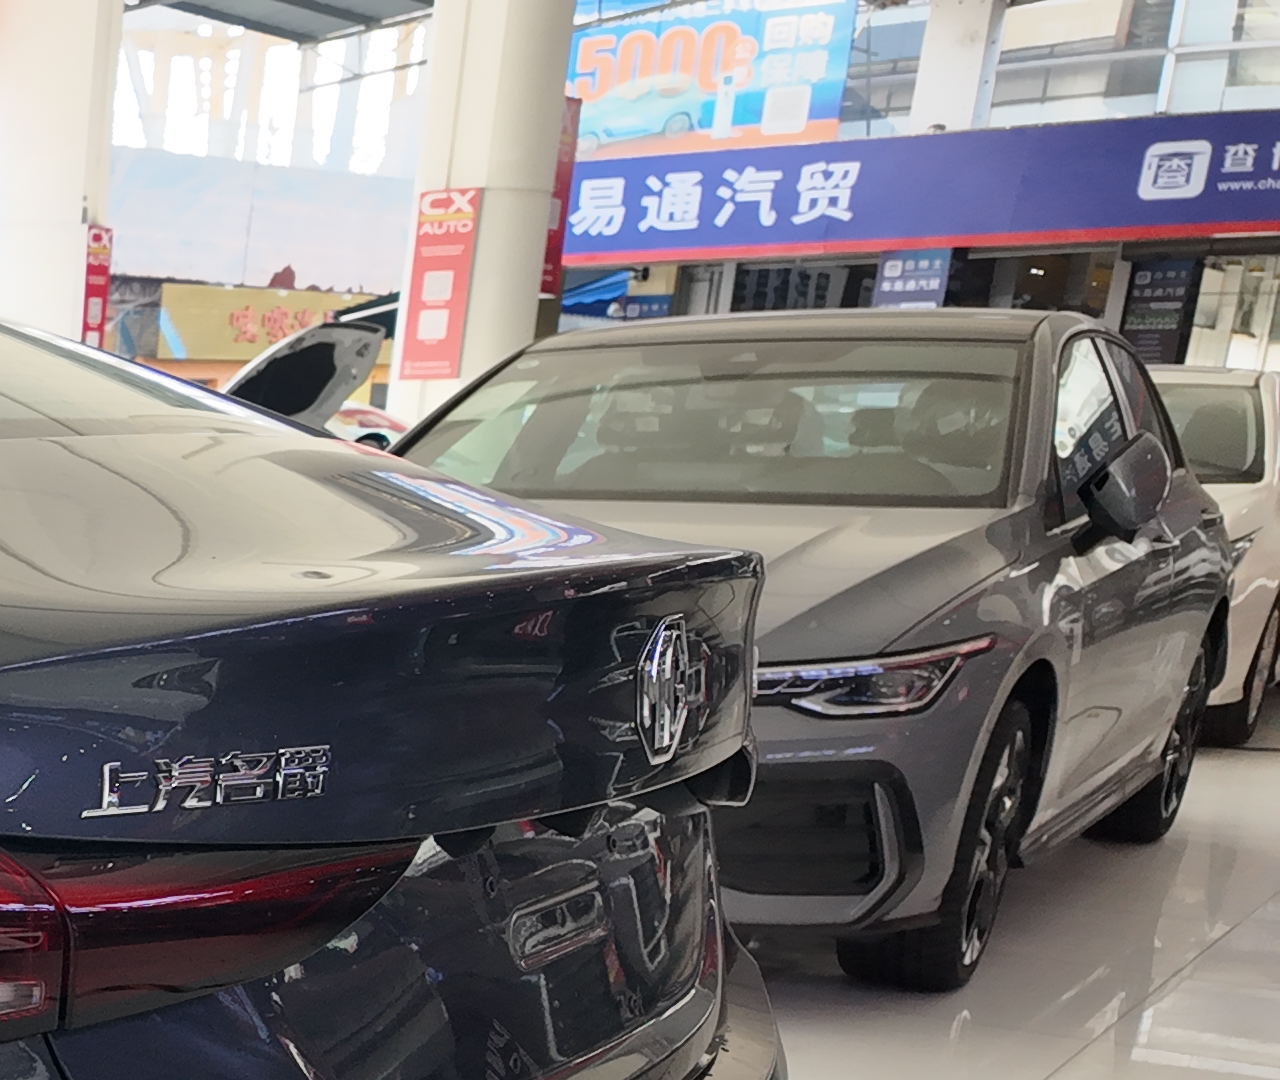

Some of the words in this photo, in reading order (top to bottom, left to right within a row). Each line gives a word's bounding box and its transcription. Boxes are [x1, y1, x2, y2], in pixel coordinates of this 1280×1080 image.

[575, 21, 742, 103] 5000
[1220, 142, 1280, 173] 查
[421, 190, 477, 215] CX
[568, 160, 862, 237] 易通汽贸
[88, 228, 113, 250] CX
[419, 219, 475, 236] AUTO
[81, 745, 331, 819] 上汽名爵
